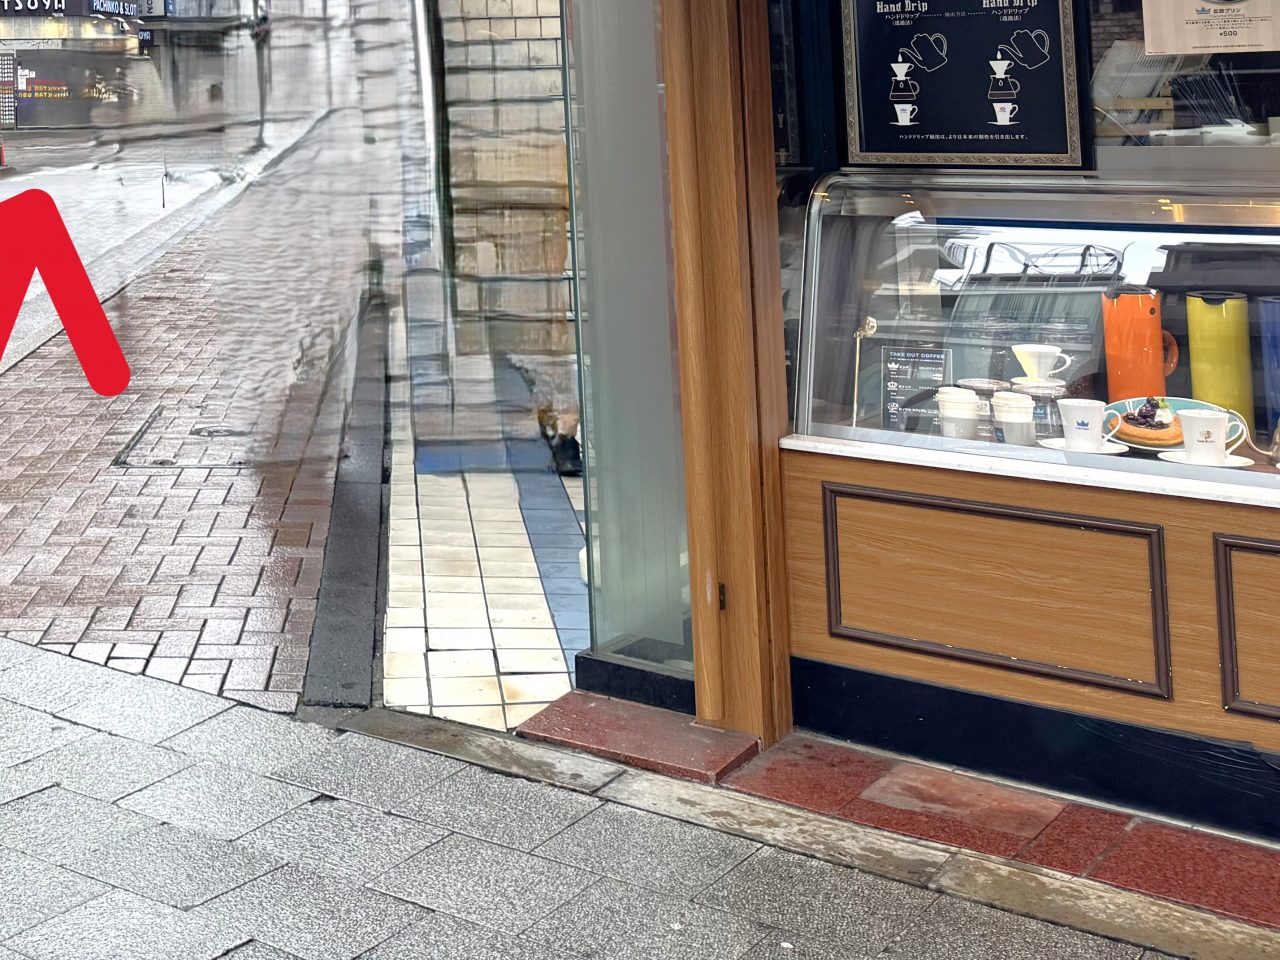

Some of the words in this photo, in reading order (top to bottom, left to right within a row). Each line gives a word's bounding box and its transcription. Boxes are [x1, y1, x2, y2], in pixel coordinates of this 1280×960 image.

[120, 2, 124, 14] &
[124, 2, 137, 16] SLOT
[876, 1, 902, 13] Hand
[905, 0, 928, 12] Drip
